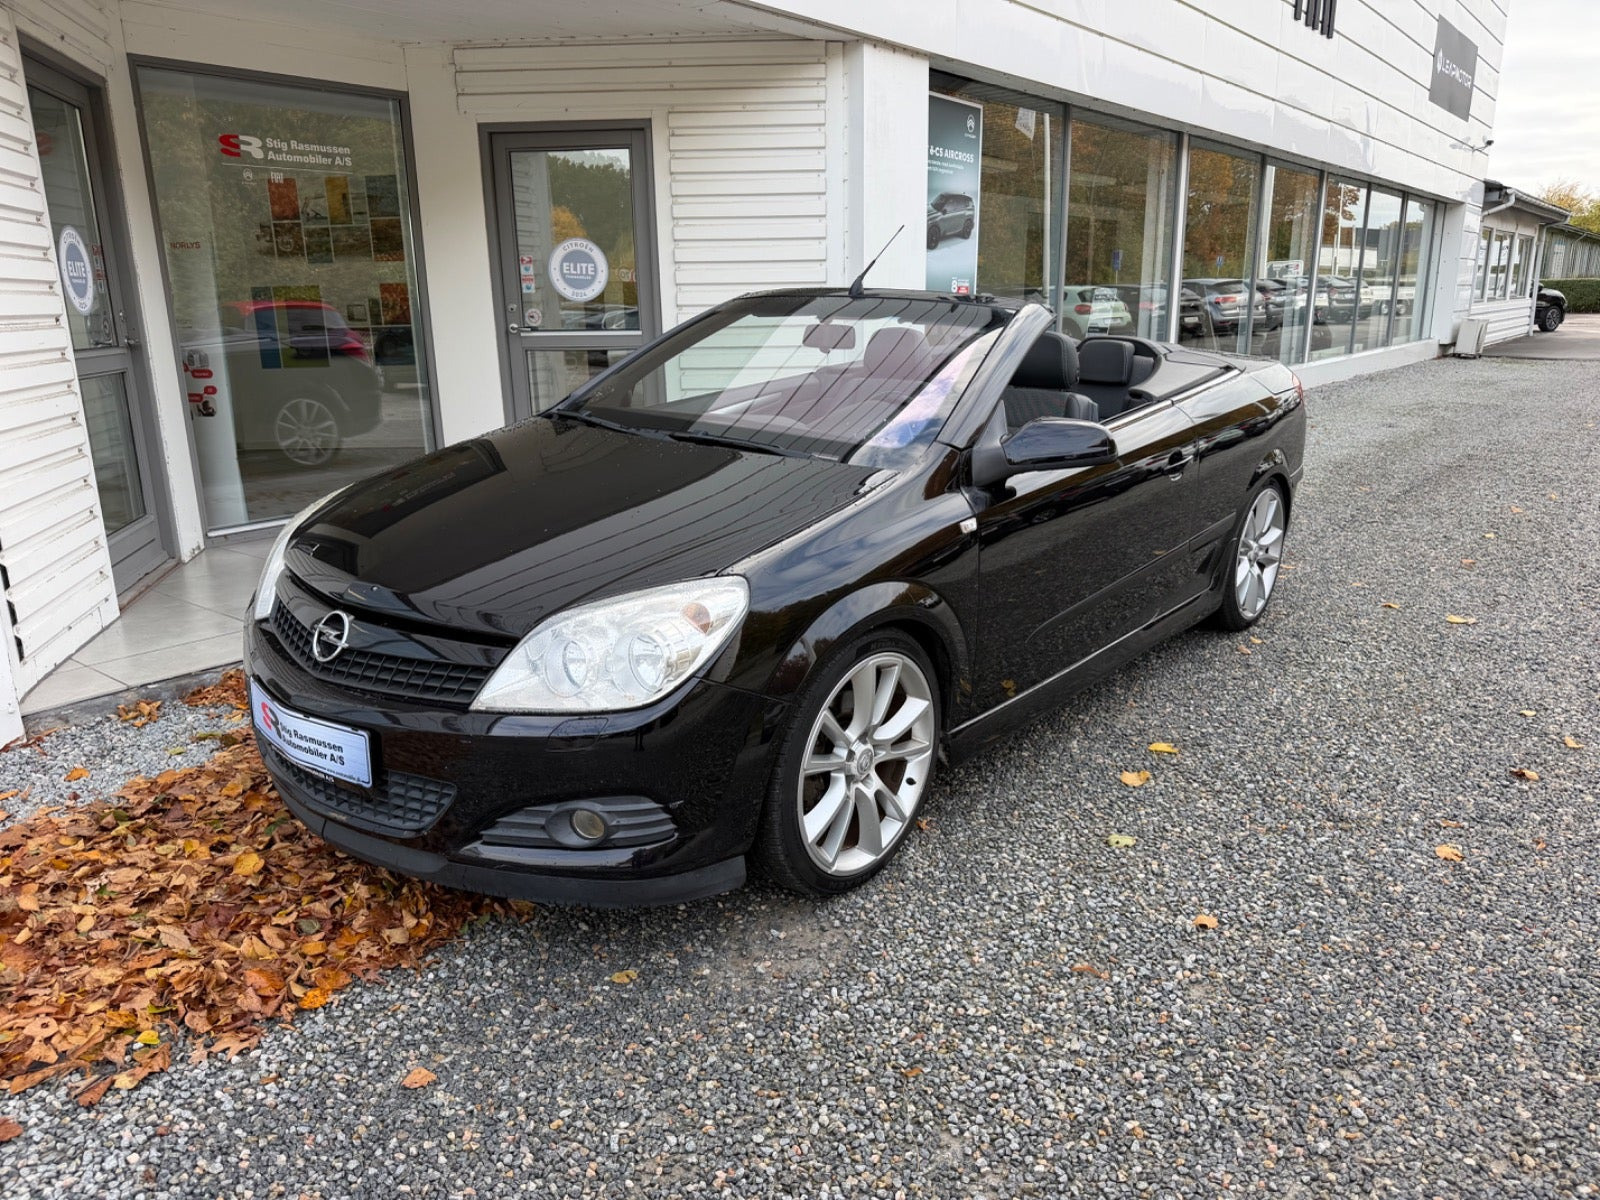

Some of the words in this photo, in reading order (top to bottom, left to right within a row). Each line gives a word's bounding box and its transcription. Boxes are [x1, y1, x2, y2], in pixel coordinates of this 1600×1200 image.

[1441, 56, 1472, 89] LEAPMOTOR
[266, 138, 288, 150] Stig
[290, 141, 351, 154] Rasmussen
[267, 150, 332, 165] Automobiler
[334, 156, 353, 166] A/S
[944, 148, 975, 163] AIRCROSS
[67, 260, 86, 278] ELITE
[562, 262, 595, 275] ELITE
[293, 729, 344, 754] Rasmussen
[282, 735, 328, 760] Automobiler
[329, 752, 345, 766] A/S
